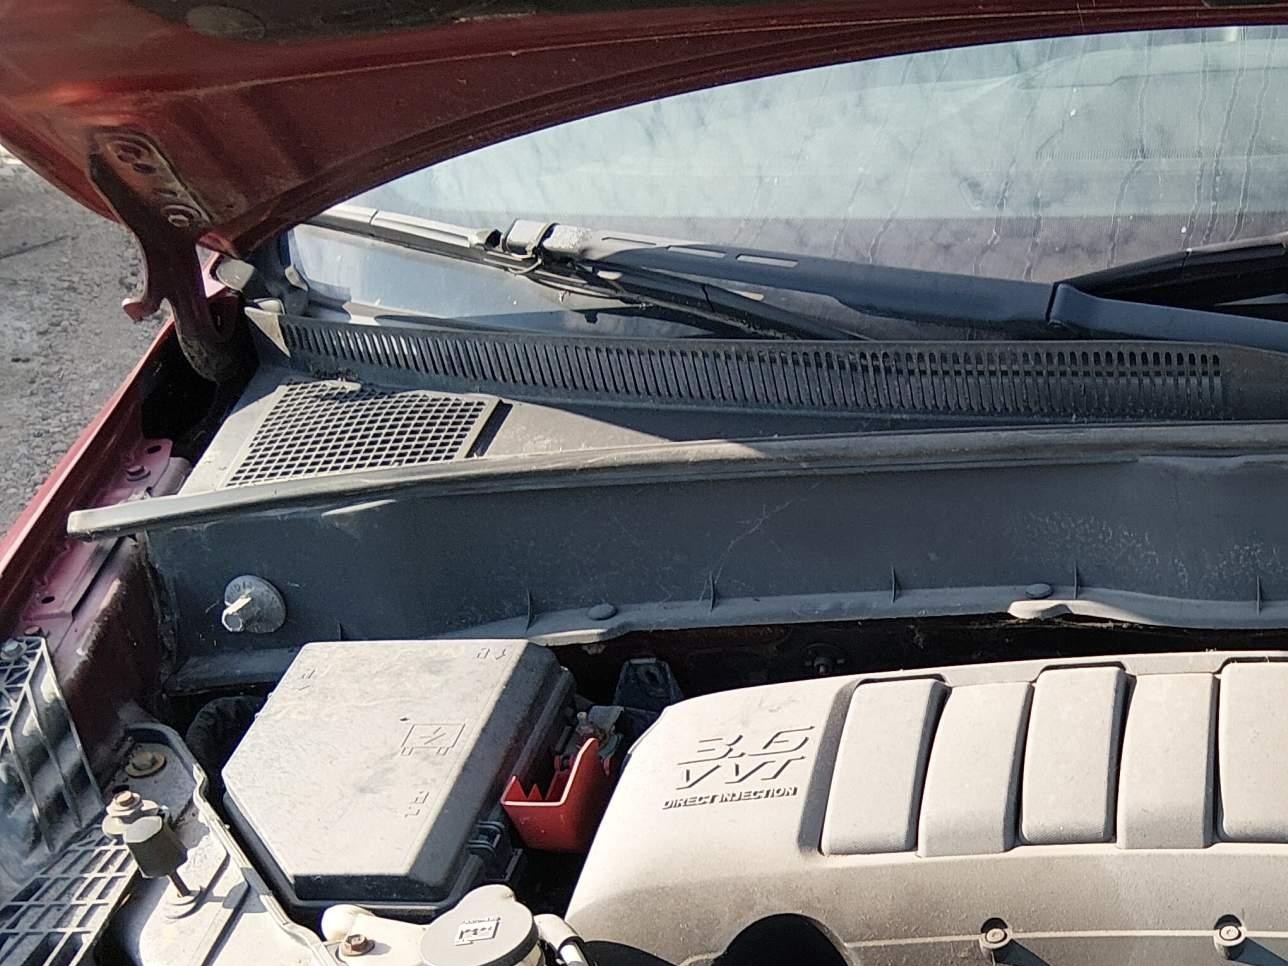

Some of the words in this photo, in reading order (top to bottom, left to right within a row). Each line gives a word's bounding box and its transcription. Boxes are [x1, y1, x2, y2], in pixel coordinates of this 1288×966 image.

[677, 725, 815, 765] 3.6
[675, 755, 805, 790] VVT
[662, 794, 718, 810] DIRECT
[719, 787, 799, 804] INJECTION
